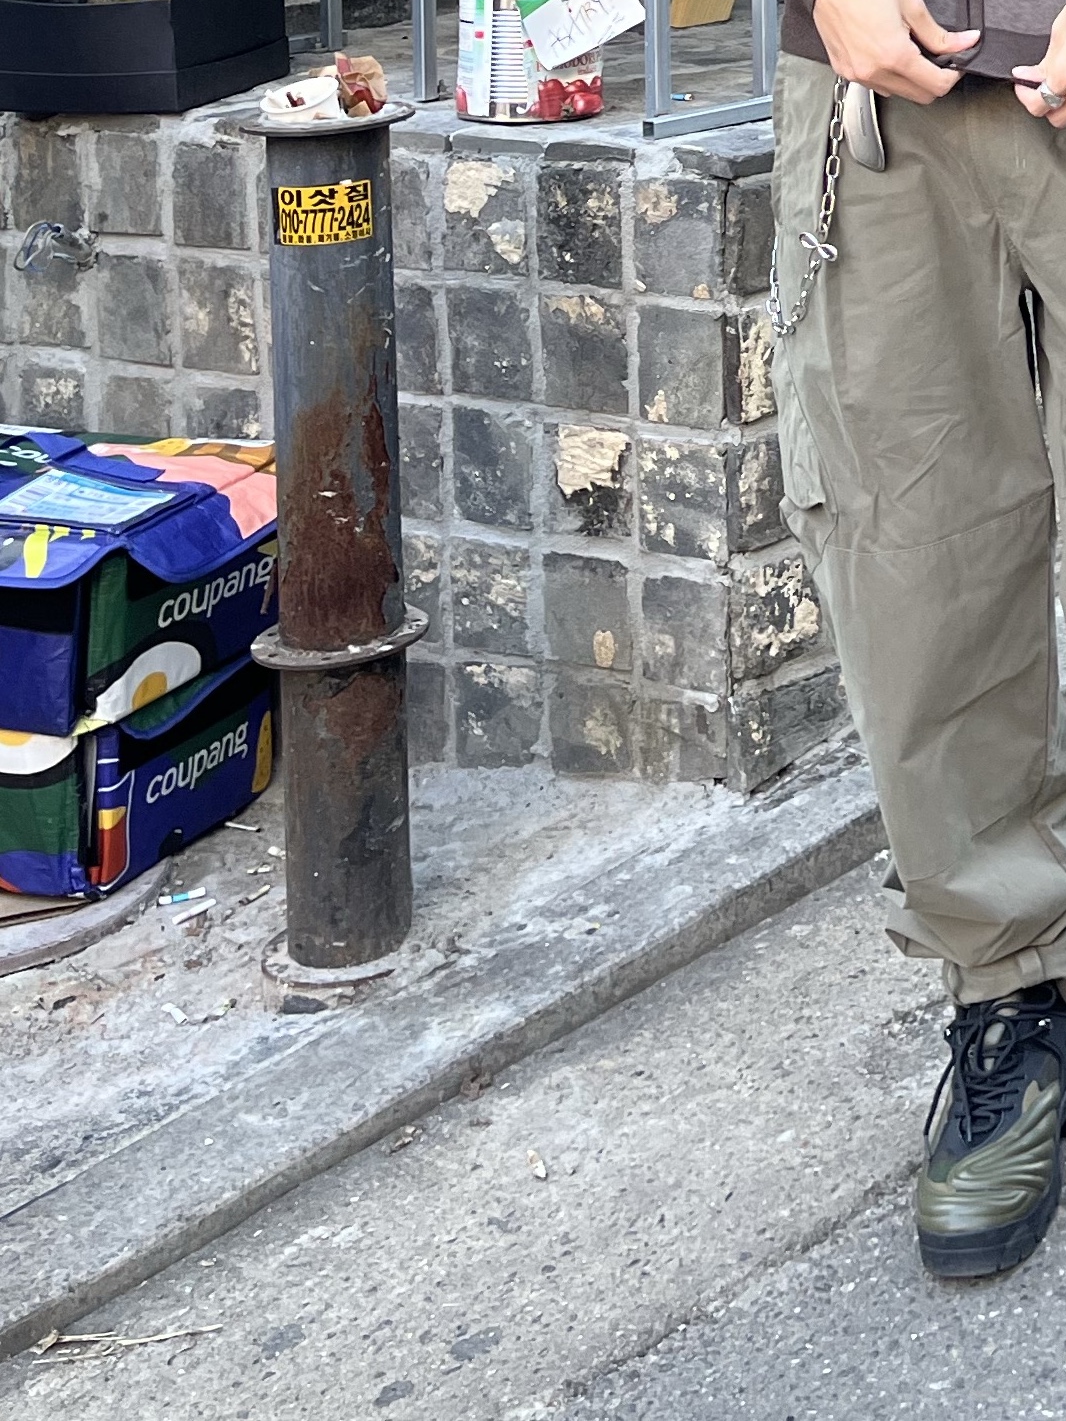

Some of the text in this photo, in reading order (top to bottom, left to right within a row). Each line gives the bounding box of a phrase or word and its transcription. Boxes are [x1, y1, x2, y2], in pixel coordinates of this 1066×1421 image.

[280, 182, 370, 208] 이삿짐
[280, 202, 370, 234] 010-7777-2424
[158, 557, 275, 628] coupang
[146, 721, 249, 804] coupang
